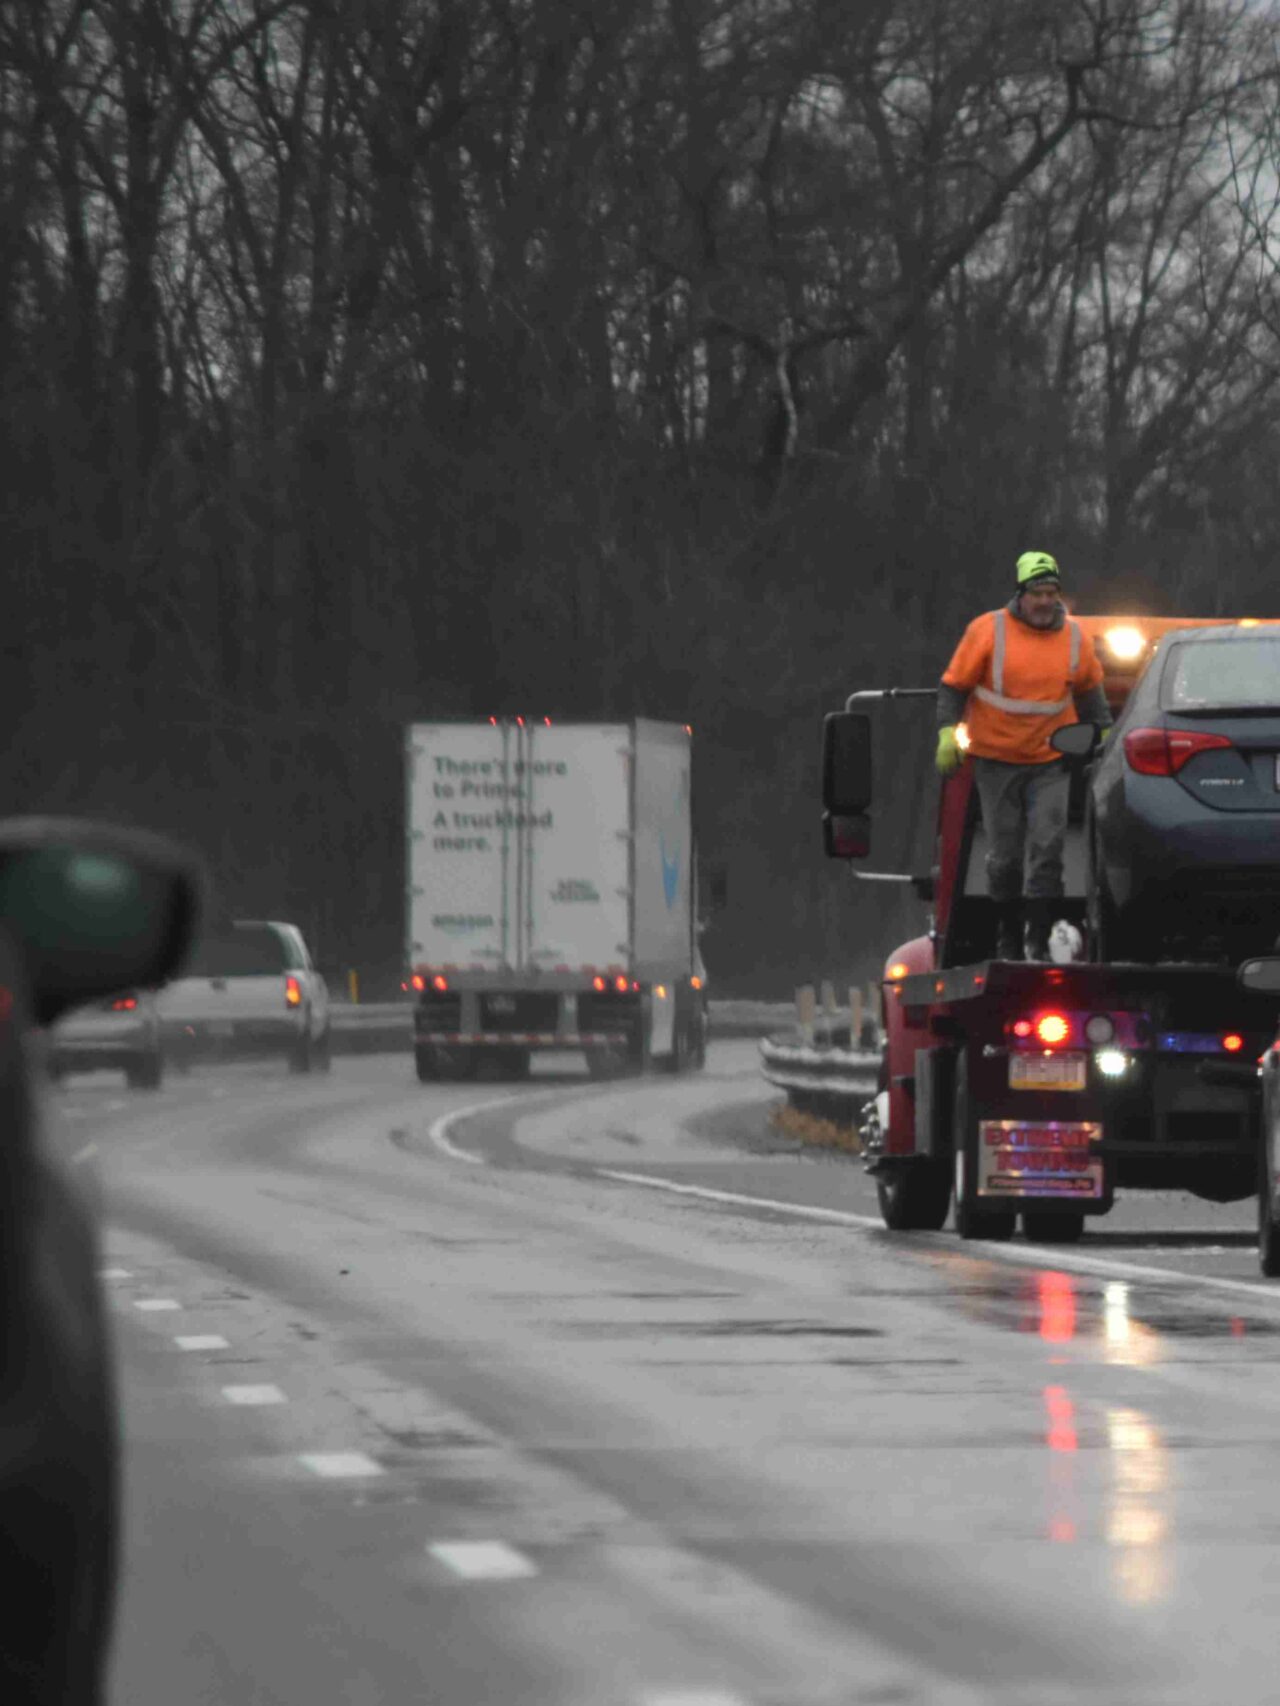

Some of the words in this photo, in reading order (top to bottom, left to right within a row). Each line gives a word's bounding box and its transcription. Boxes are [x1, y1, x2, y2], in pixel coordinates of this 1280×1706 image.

[433, 781, 454, 798] to
[433, 810, 447, 828] A
[432, 914, 493, 928] amazon
